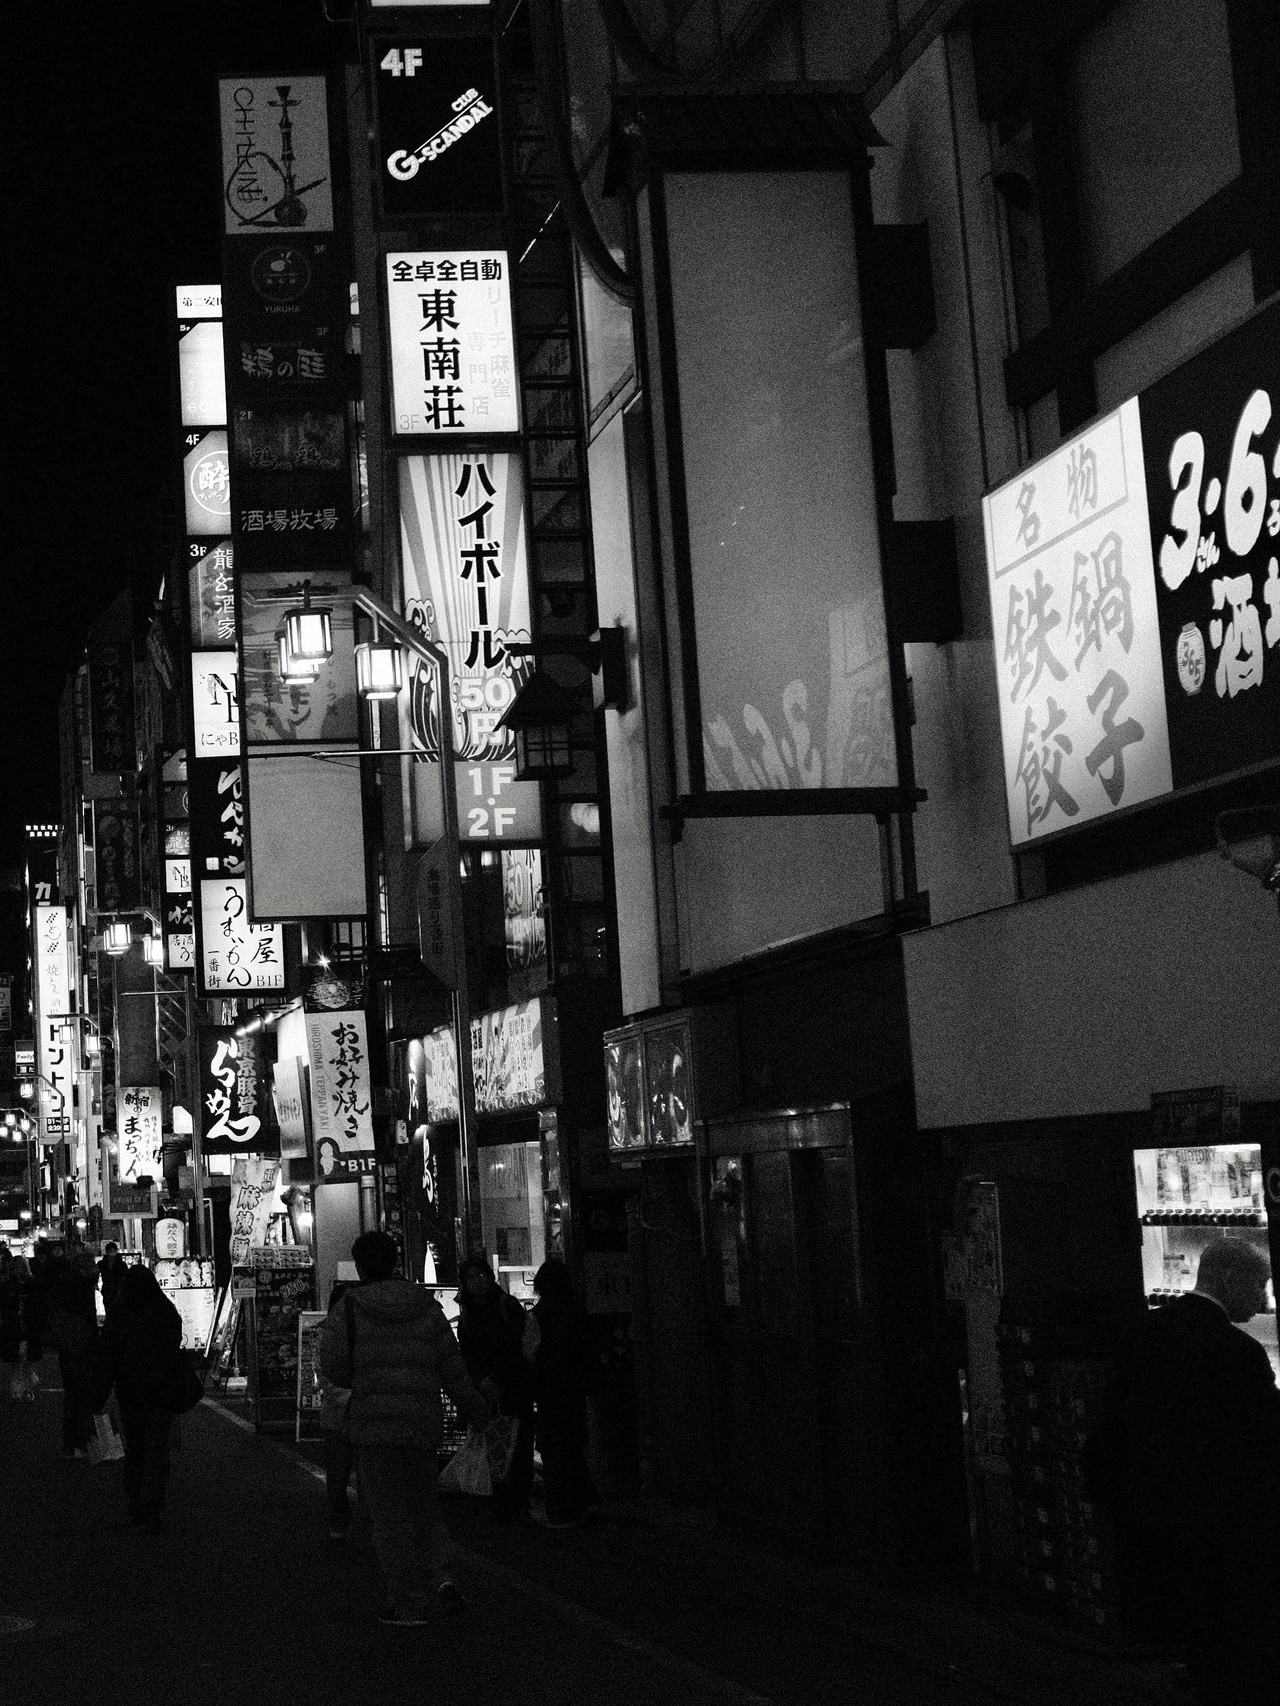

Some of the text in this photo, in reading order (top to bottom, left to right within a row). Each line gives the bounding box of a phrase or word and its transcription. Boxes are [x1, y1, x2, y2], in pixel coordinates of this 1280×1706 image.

[381, 48, 422, 77] 4F
[451, 88, 479, 112] CLUB
[387, 101, 493, 181] G-SCANDAL
[392, 259, 502, 282] 全卓全自動
[417, 288, 465, 430] 東南荘
[487, 287, 511, 399] リーチ麻雀
[466, 332, 489, 416] 専門店
[240, 411, 253, 420] 2F
[399, 414, 420, 430] 3F
[186, 435, 200, 445] 4F
[1016, 442, 1097, 550] 名物
[241, 508, 339, 531] 酒場牧場
[190, 545, 207, 556] 3F
[455, 463, 506, 669] ハイボール
[1004, 531, 1134, 703] 鉄鍋
[1181, 641, 1201, 686] 365
[470, 712, 503, 747] 円
[1015, 669, 1144, 835] 餃子
[468, 766, 514, 796] 1F
[467, 808, 516, 837] 2F
[220, 886, 252, 986] うまいもん
[208, 950, 221, 988] 一番街
[256, 975, 282, 986] B1F
[237, 1038, 257, 1114] 東京豚骨
[311, 1024, 329, 1130] HIROSHIMA TEPPANYAKI
[329, 1022, 369, 1139] お好み焼き
[125, 1092, 150, 1107] 新宿
[124, 1116, 144, 1178] まっちゃん
[348, 1158, 376, 1172] B1F
